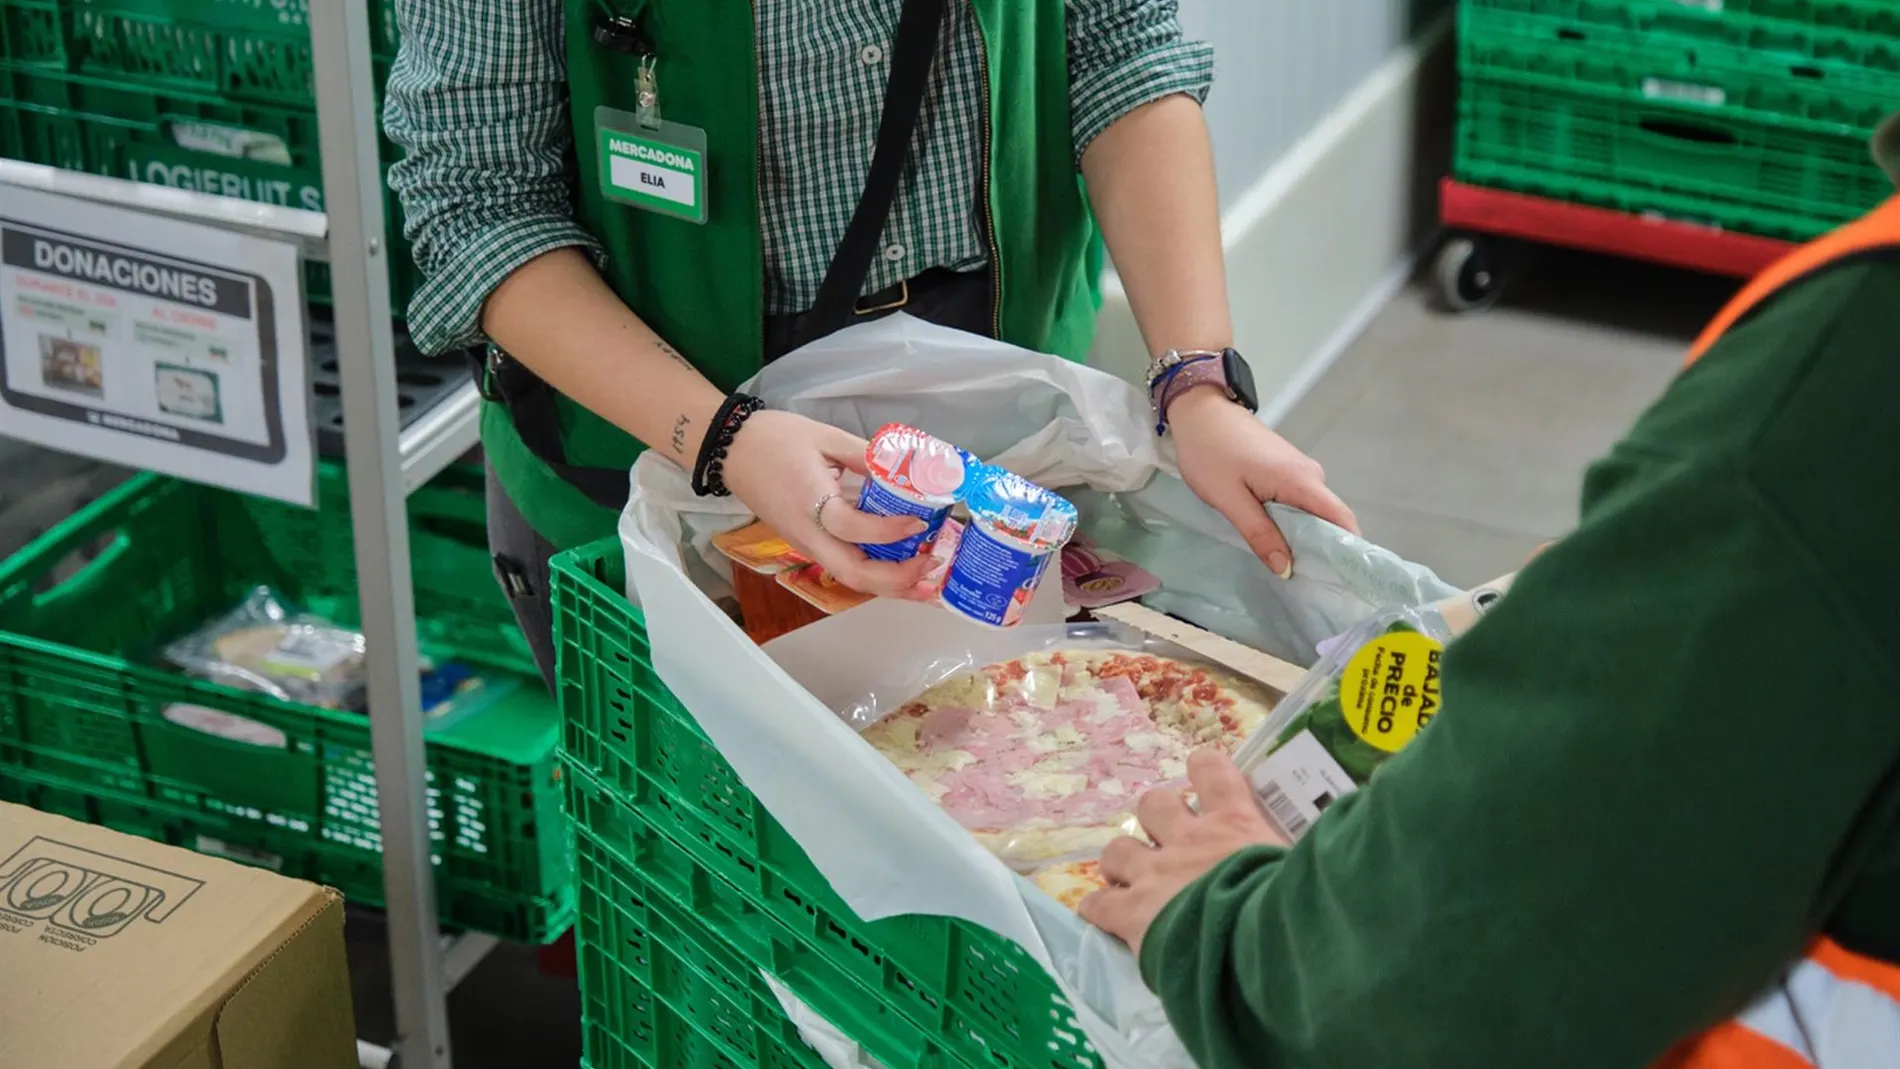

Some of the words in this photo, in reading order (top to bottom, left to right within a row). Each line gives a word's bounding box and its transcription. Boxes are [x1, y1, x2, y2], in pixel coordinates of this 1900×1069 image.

[609, 138, 694, 171] MERCADONA
[640, 172, 665, 189] ELIA
[33, 239, 219, 306] DONACIONES
[1373, 646, 1385, 675] Fecha
[1370, 677, 1379, 690] de
[1377, 651, 1406, 734] PRECIO
[1401, 684, 1418, 707] de
[1416, 649, 1440, 734] BAJAD
